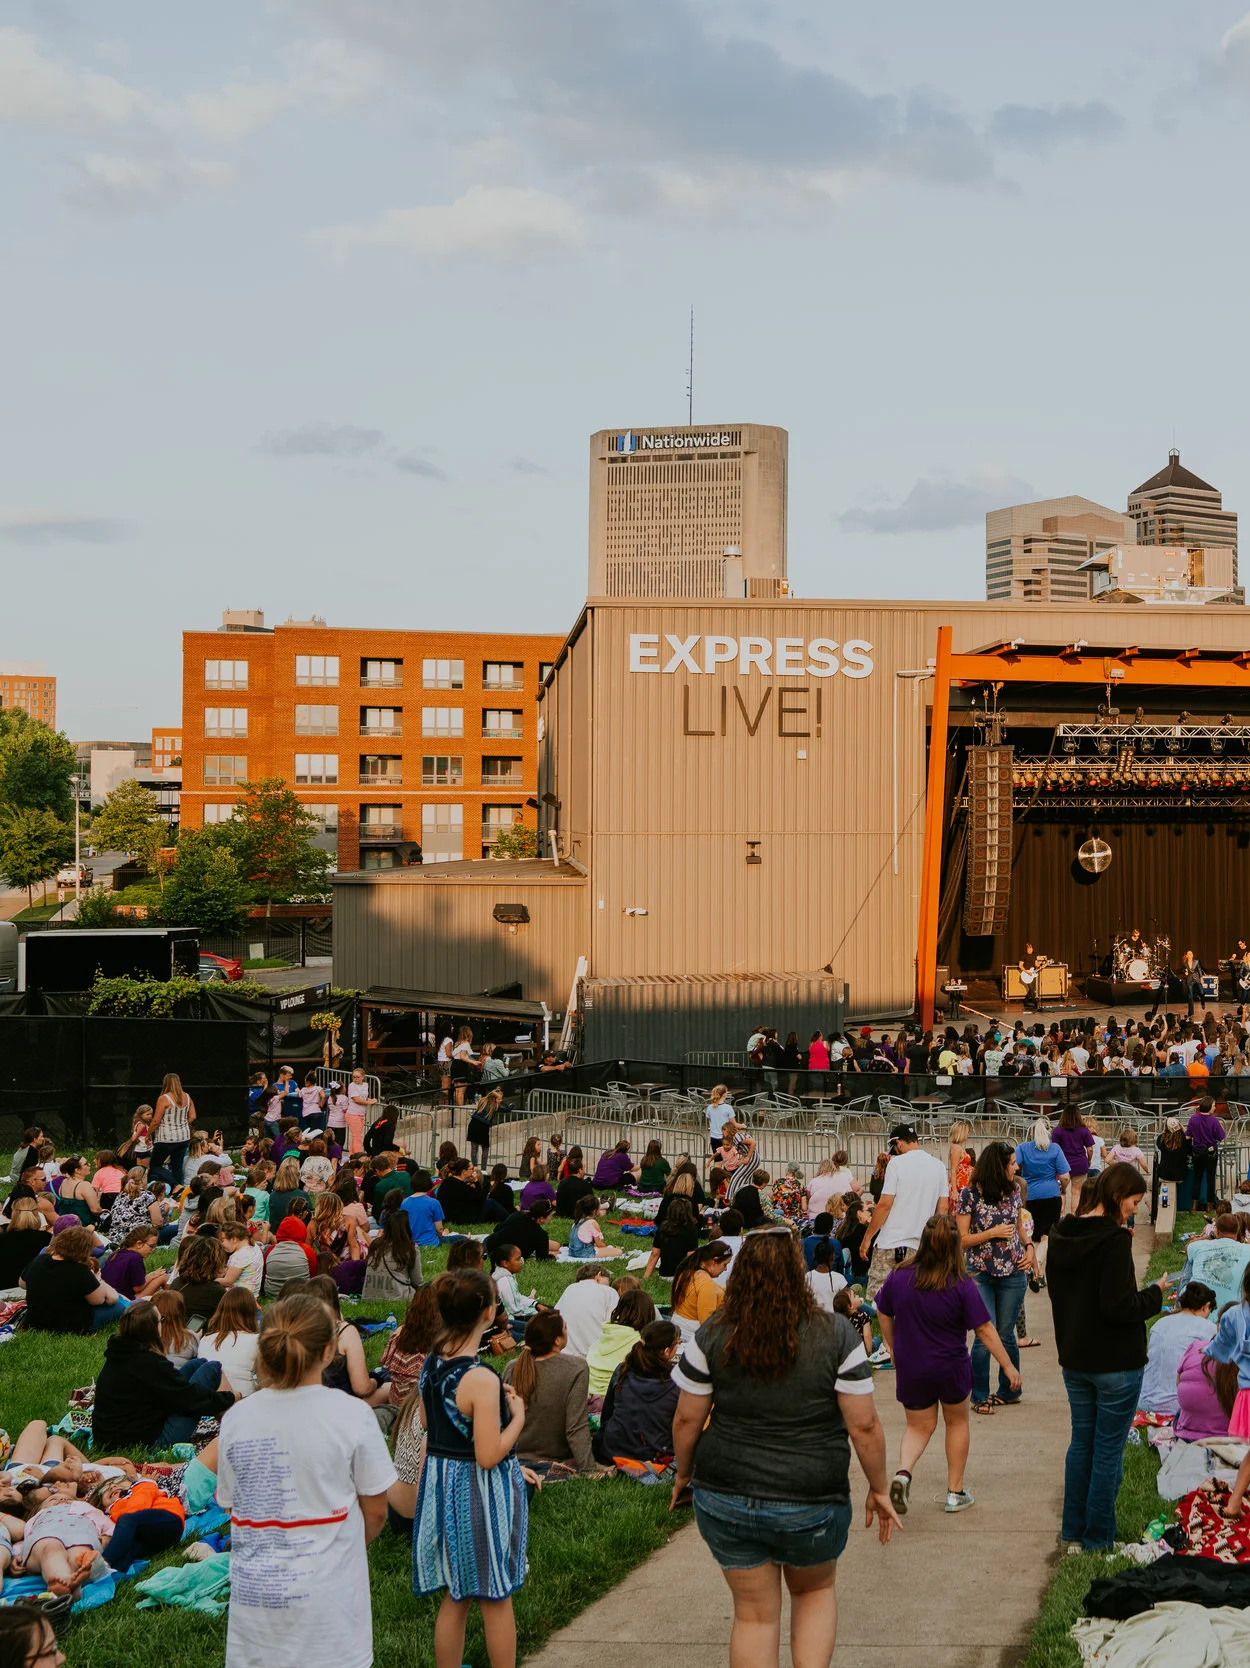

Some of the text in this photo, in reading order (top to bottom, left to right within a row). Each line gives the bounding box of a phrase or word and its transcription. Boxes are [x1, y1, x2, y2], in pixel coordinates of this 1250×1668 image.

[642, 432, 730, 450] Nationwide
[629, 633, 874, 679] EXPRESS
[684, 685, 821, 738] LIVE!
[280, 994, 305, 1010] VIP LOUNGE
